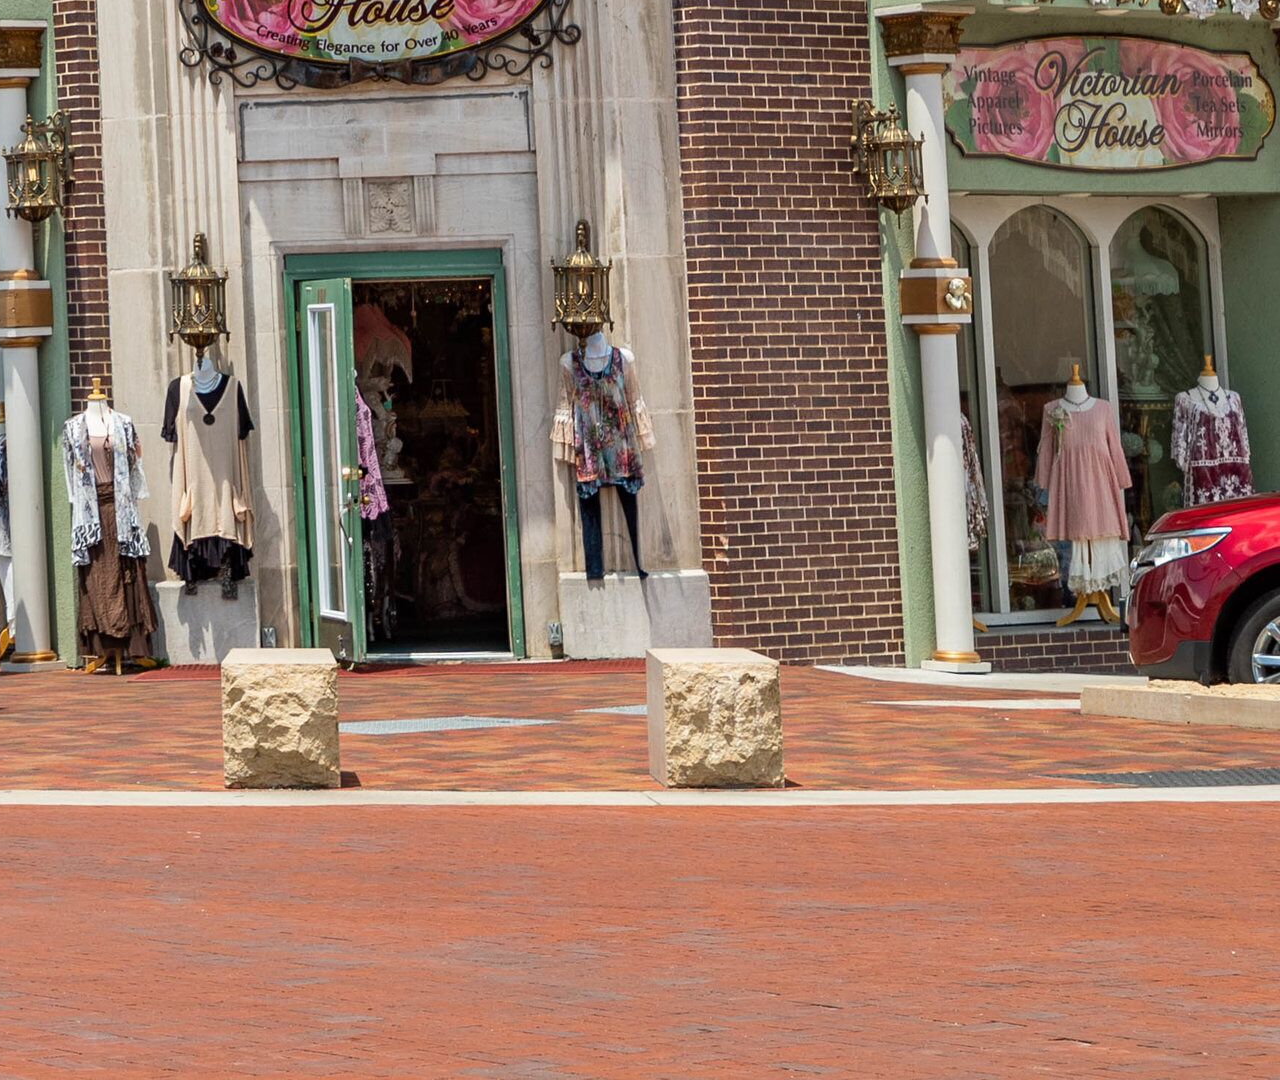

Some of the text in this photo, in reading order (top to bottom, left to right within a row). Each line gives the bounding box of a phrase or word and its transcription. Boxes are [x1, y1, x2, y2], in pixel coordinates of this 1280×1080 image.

[256, 16, 499, 55] Creating Elegance for Over 40 Years
[964, 66, 1017, 87] Vintage
[1034, 47, 1183, 100] Victorian
[1193, 72, 1253, 89] Porcelain
[967, 93, 1021, 112] Apparel
[1193, 98, 1247, 113] Tea Sets
[968, 118, 1024, 136] Pictures
[1054, 99, 1167, 153] House
[1196, 121, 1244, 139] Mirrors
